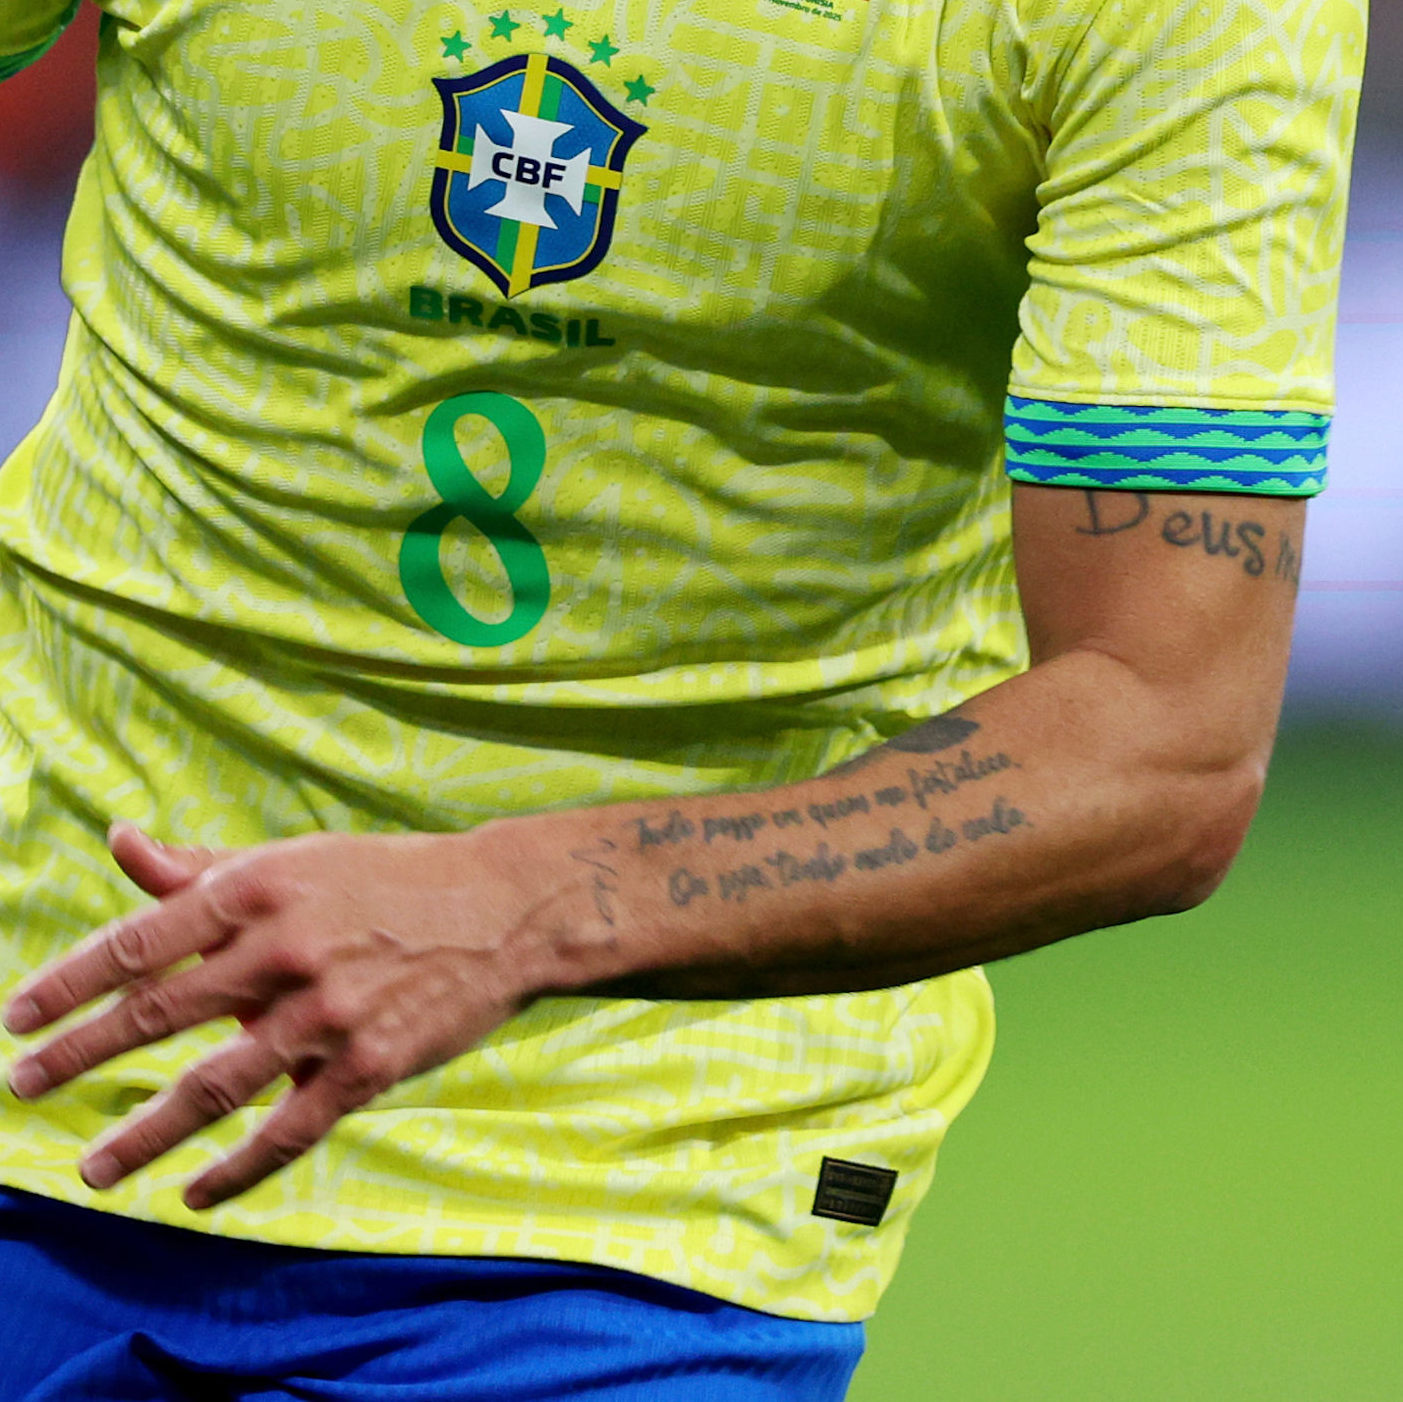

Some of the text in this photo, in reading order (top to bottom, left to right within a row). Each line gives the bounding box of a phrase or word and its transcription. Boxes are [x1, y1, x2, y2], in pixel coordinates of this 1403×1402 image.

[492, 152, 566, 189] CBF
[409, 285, 616, 348] BRASIL
[398, 389, 551, 648] 8
[1076, 490, 1265, 577] Deus
